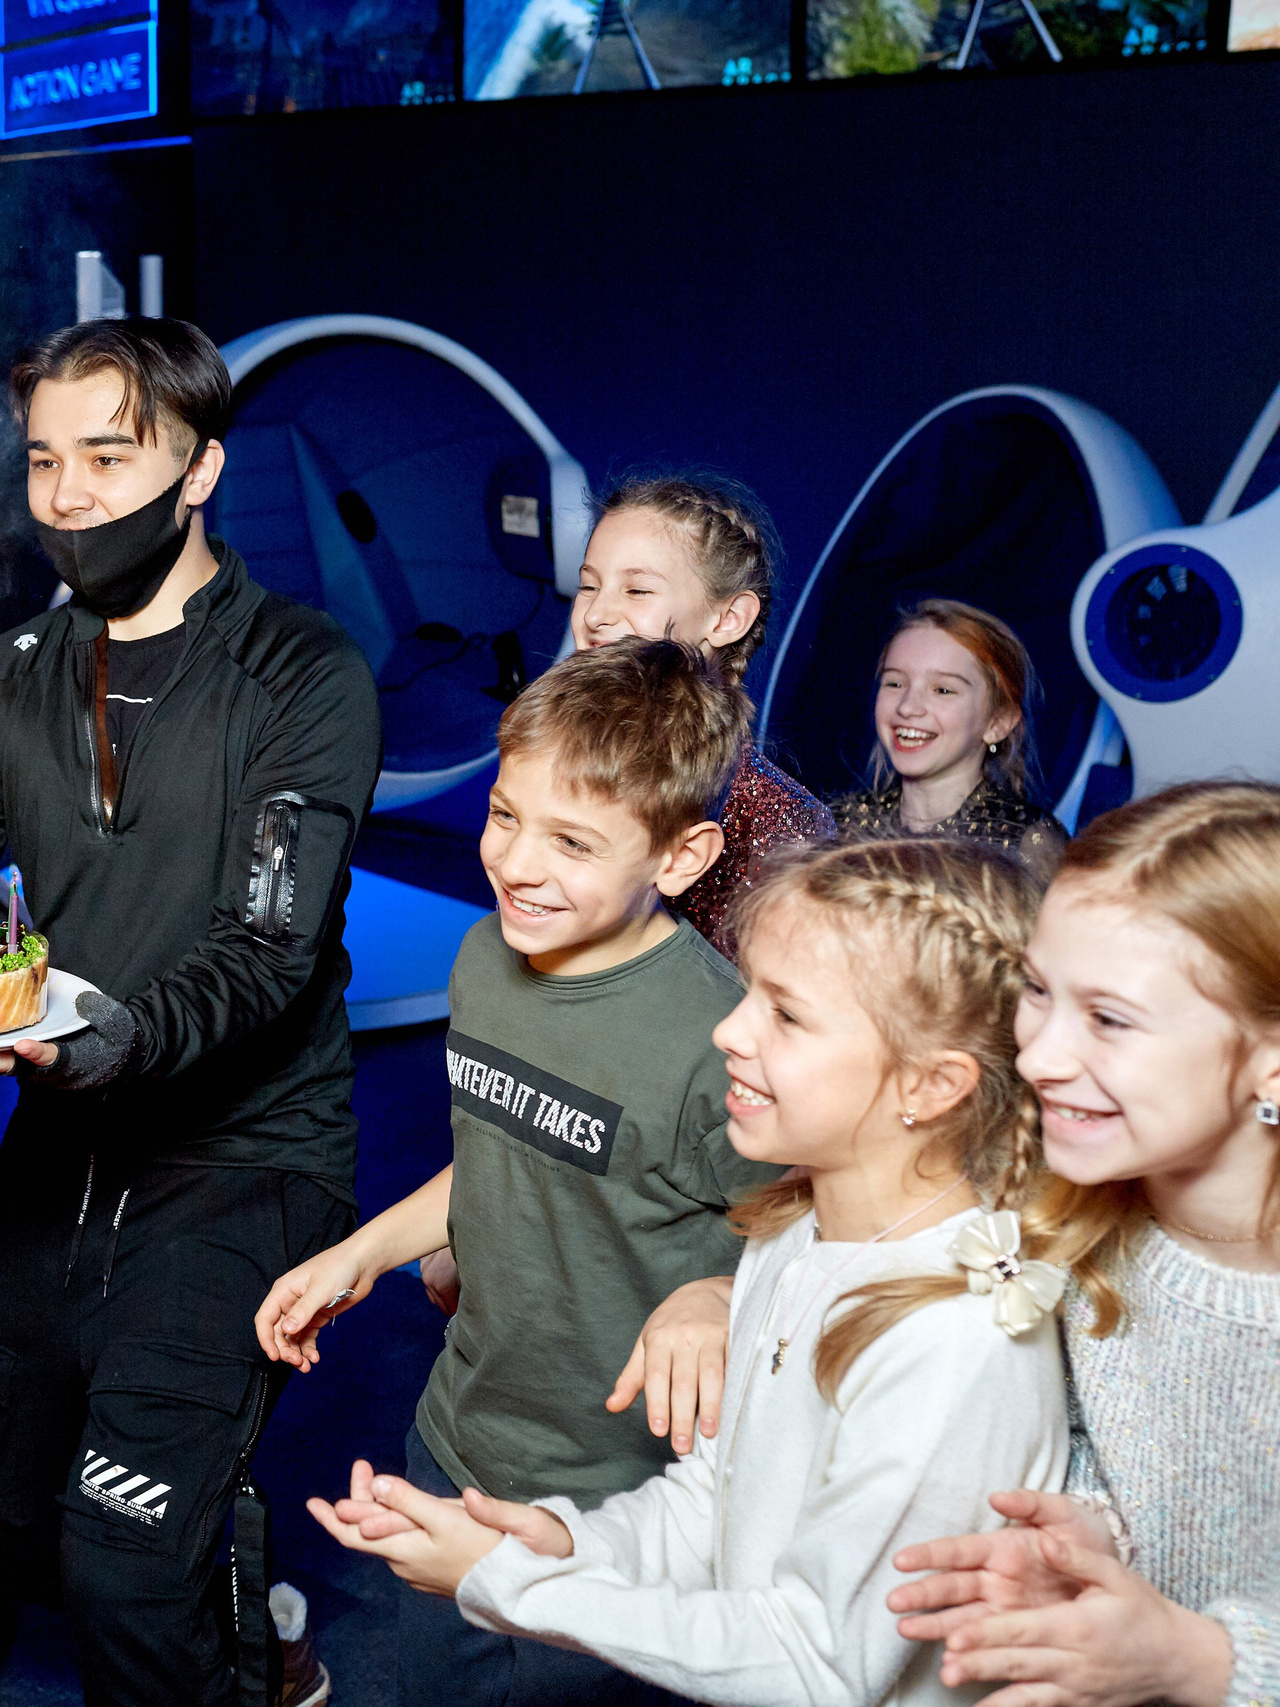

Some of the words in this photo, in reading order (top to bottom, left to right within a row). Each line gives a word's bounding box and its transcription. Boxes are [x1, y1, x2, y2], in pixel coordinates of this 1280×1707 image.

[9, 63, 80, 111] ACTION
[81, 52, 141, 96] GAME
[511, 1082, 536, 1120] IT
[532, 1092, 606, 1154] TAKES
